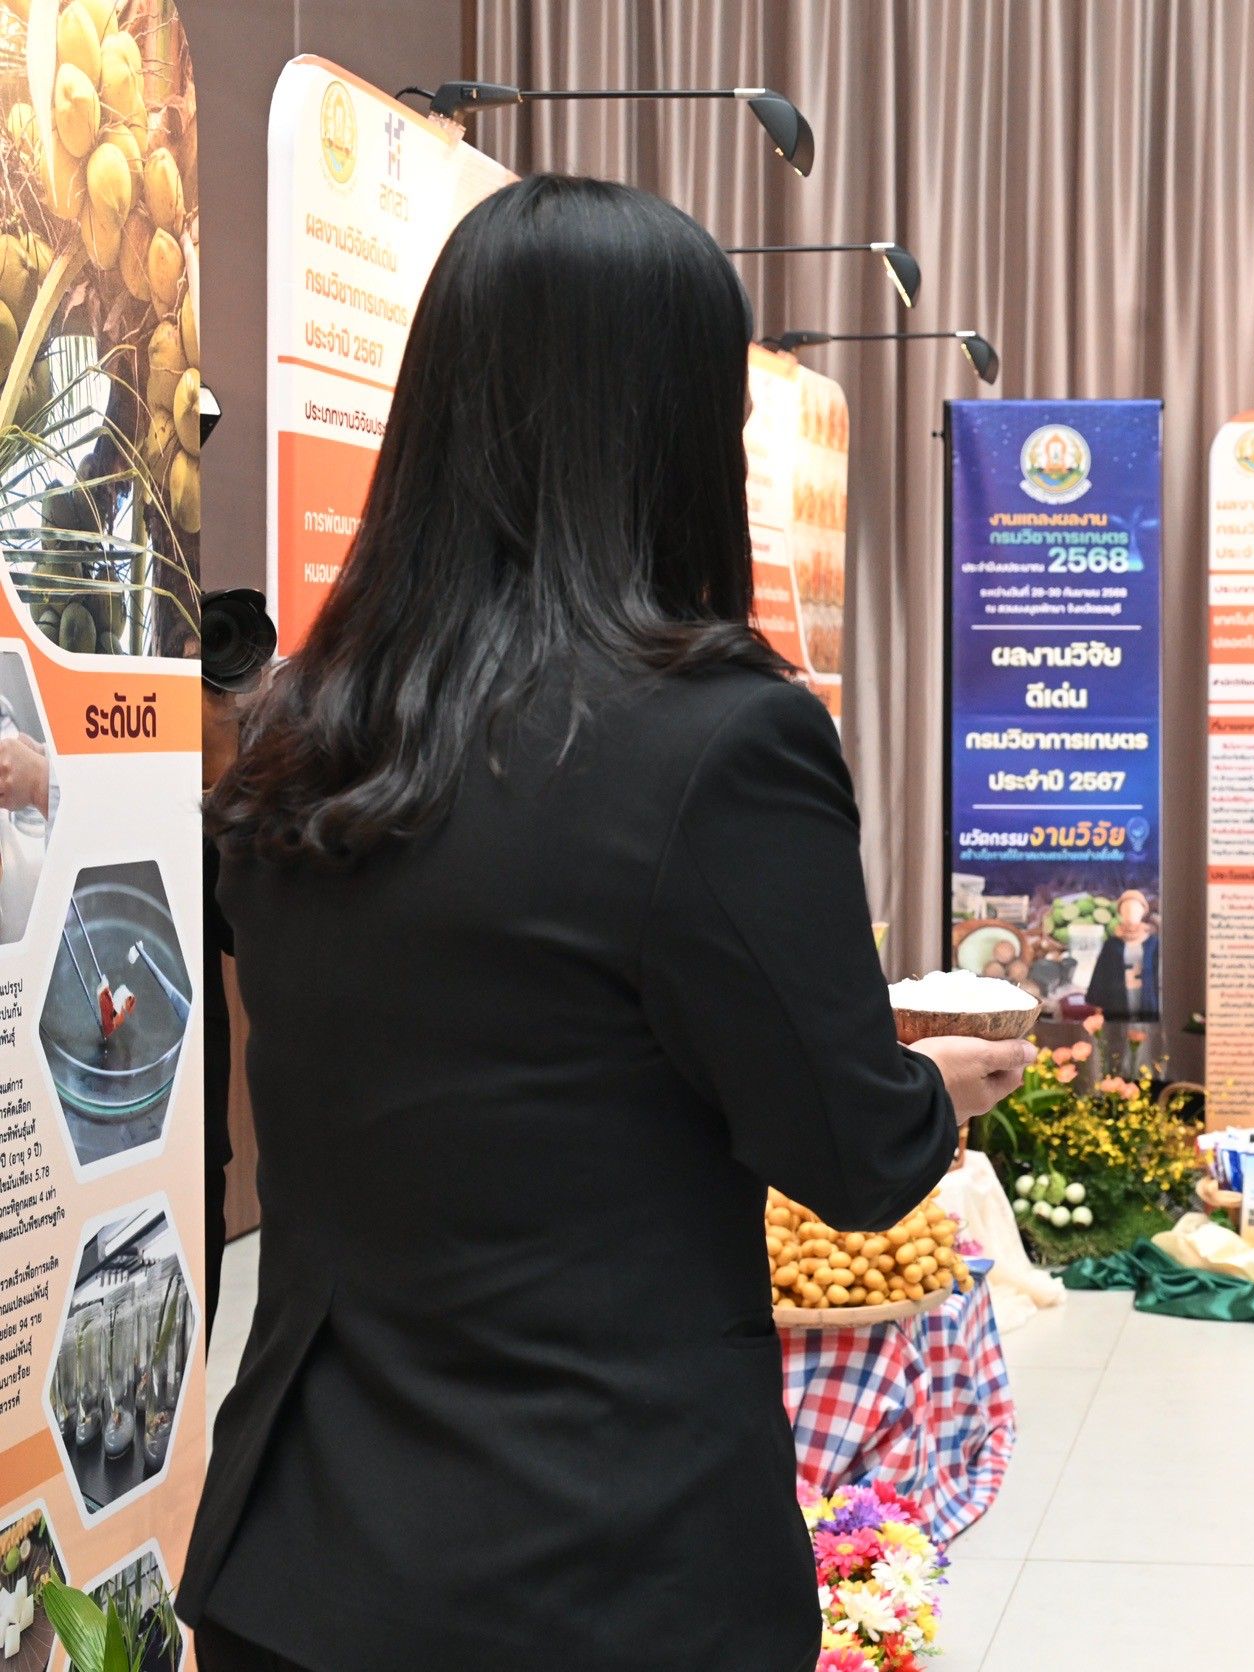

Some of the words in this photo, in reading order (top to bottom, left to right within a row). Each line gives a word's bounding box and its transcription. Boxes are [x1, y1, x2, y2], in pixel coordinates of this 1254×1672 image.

[306, 268, 407, 328] กรมวิชาการเกษตร
[306, 319, 351, 358] ประจำปี
[353, 341, 384, 368] 2567
[989, 528, 1129, 545] กรมวิชาการเกษตร
[1047, 547, 1129, 573] 2568
[991, 641, 1122, 667] ผลงานวิจัย
[1025, 682, 1088, 708] ดีเด่น
[85, 692, 157, 739] ระดับดี
[966, 728, 1148, 750] กรมวิชาการเกษตร
[989, 769, 1063, 792] ประจำปี
[1069, 771, 1126, 792] 2567
[35, 1166, 50, 1181] 5.78
[20, 1318, 28, 1332] 94
